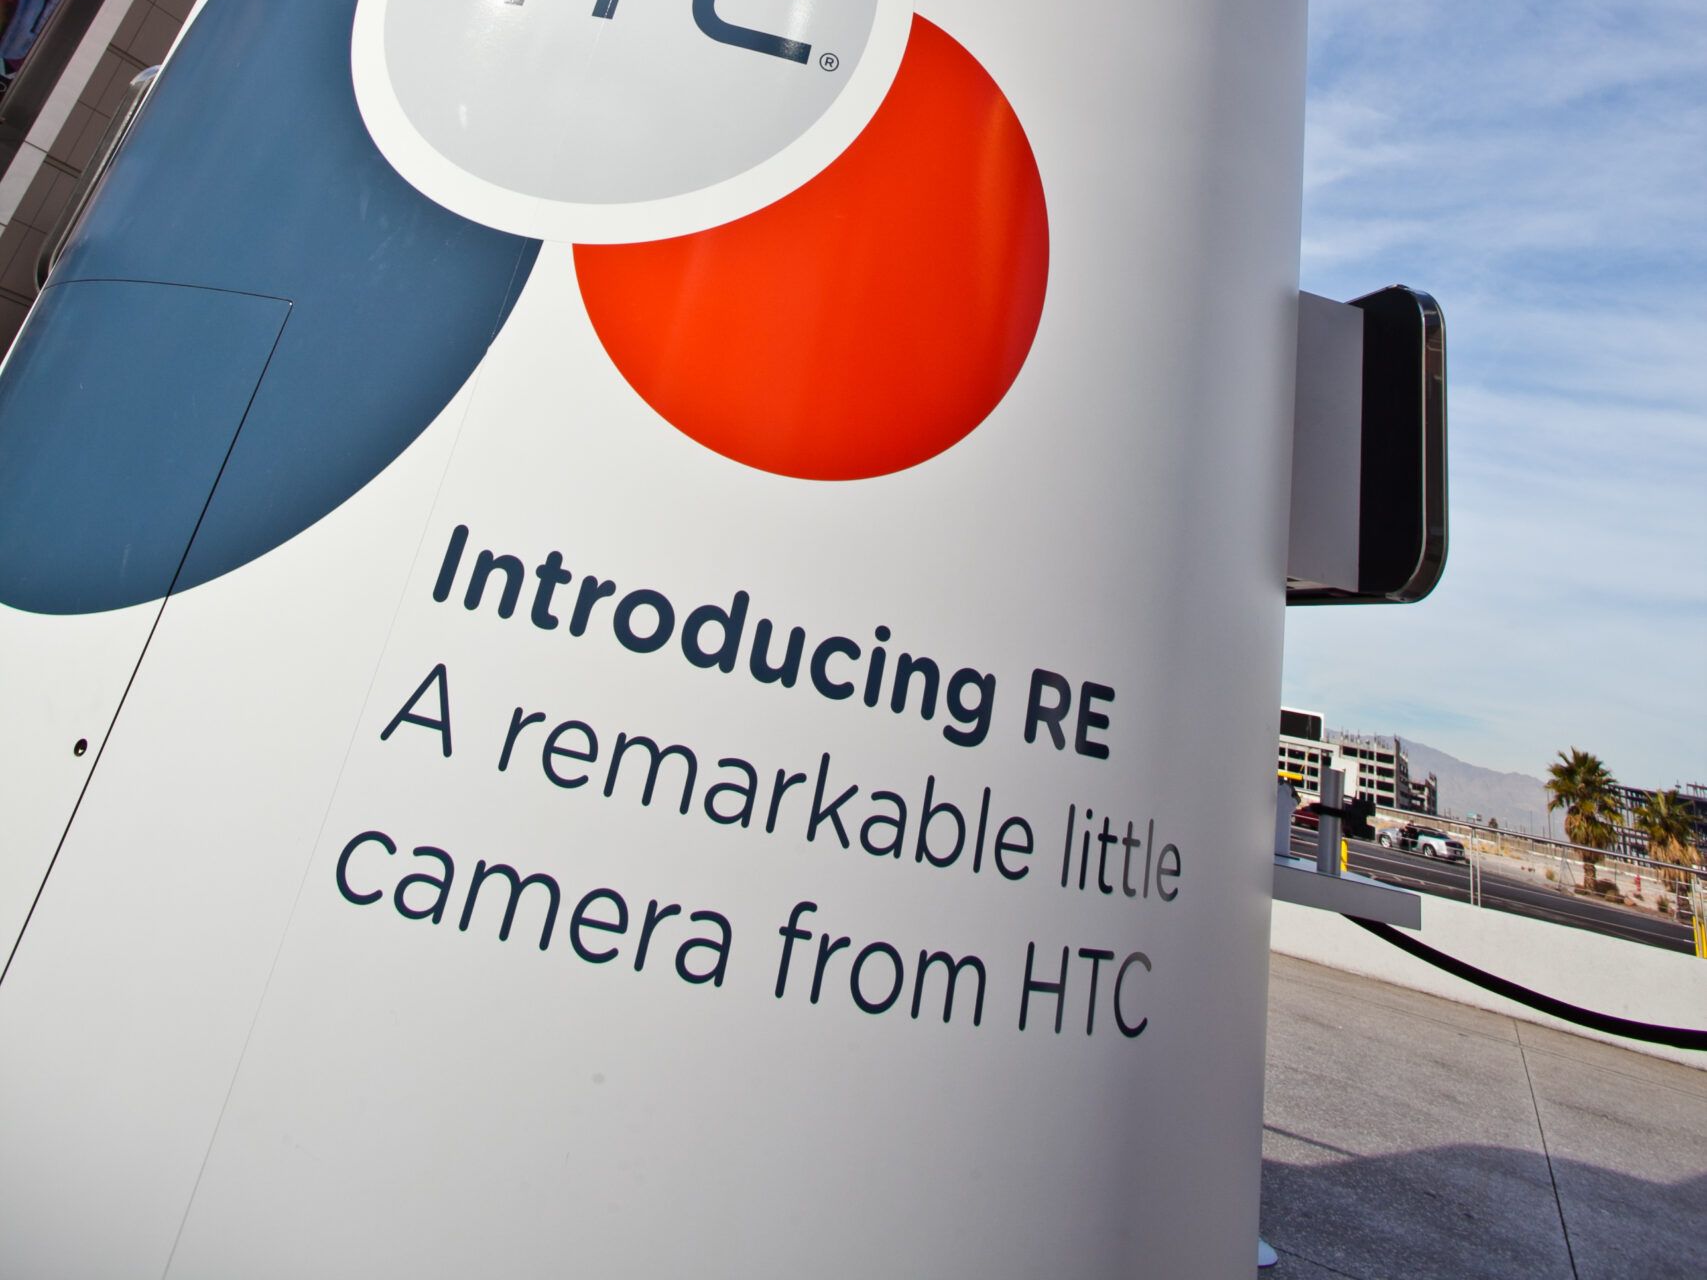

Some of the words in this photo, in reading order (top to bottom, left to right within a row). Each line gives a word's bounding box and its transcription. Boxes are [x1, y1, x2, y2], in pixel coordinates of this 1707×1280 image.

[432, 523, 998, 749] Introducing
[1023, 667, 1117, 761] RE
[379, 662, 453, 759] A
[497, 706, 1035, 882] remarkable
[1060, 803, 1183, 904] little
[335, 829, 734, 989] camera
[774, 900, 988, 1028] from
[1018, 940, 1154, 1040] HTC
